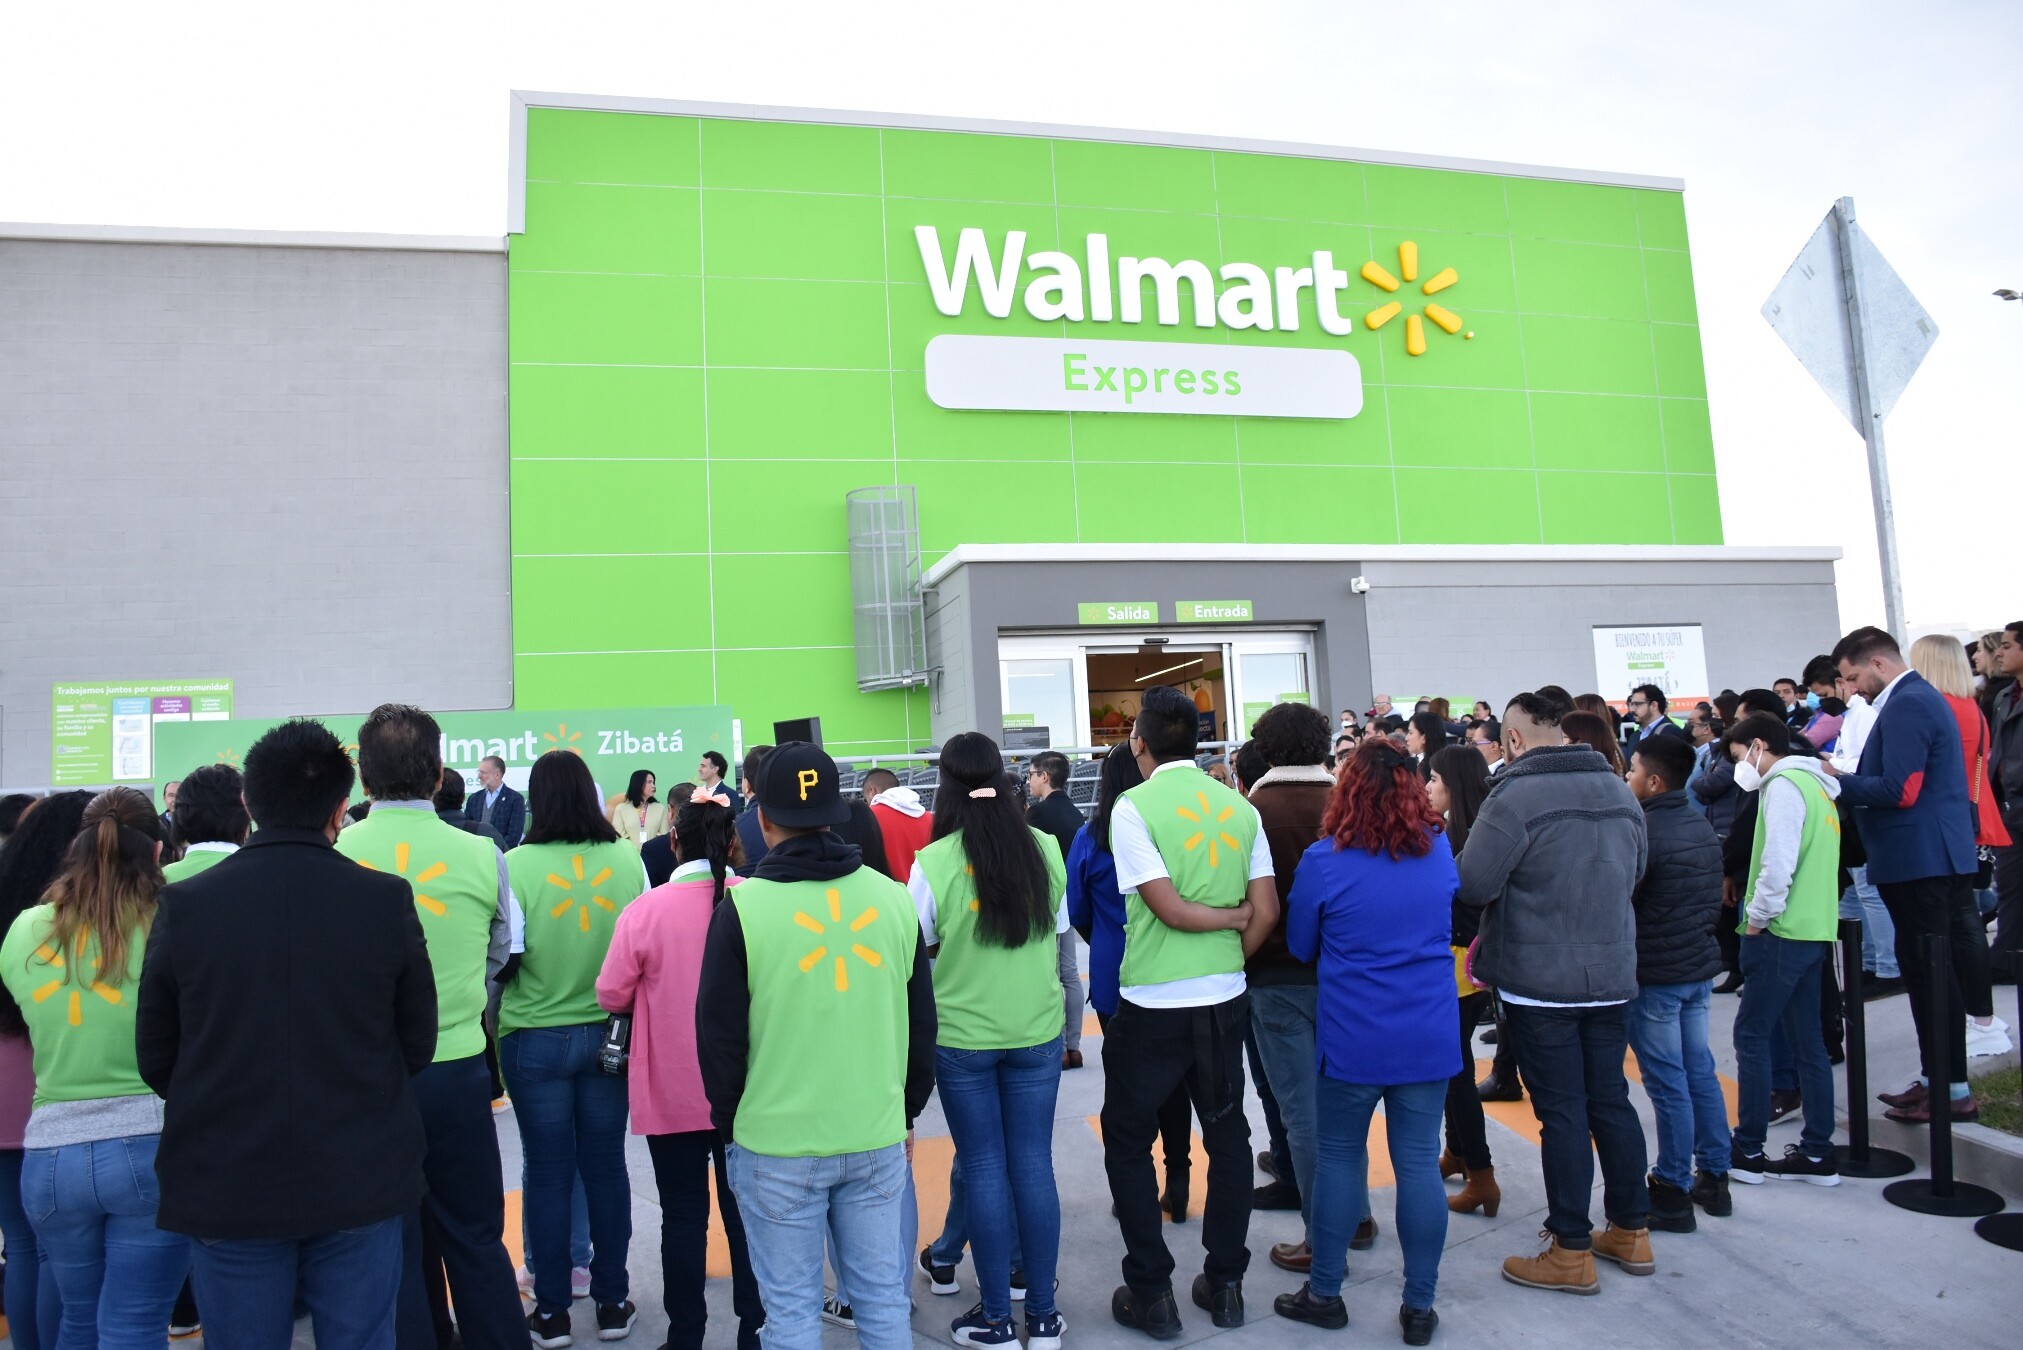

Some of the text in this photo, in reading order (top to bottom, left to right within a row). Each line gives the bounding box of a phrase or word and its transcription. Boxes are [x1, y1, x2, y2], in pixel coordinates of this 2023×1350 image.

[914, 225, 1352, 335] Walmart
[1063, 352, 1242, 404] Express
[1107, 606, 1150, 620] Salida
[1194, 604, 1249, 618] Entrada
[1615, 632, 1651, 648] BIENVENIDO
[1652, 632, 1657, 646] A
[1657, 632, 1666, 646] TU
[1626, 651, 1664, 661] Walmart
[56, 687, 105, 695] Trabajamos
[105, 686, 131, 695] juntos
[131, 686, 149, 694] por
[183, 683, 229, 691] comunidad
[439, 729, 684, 764] lmart Zibatá
[797, 769, 819, 801] P
